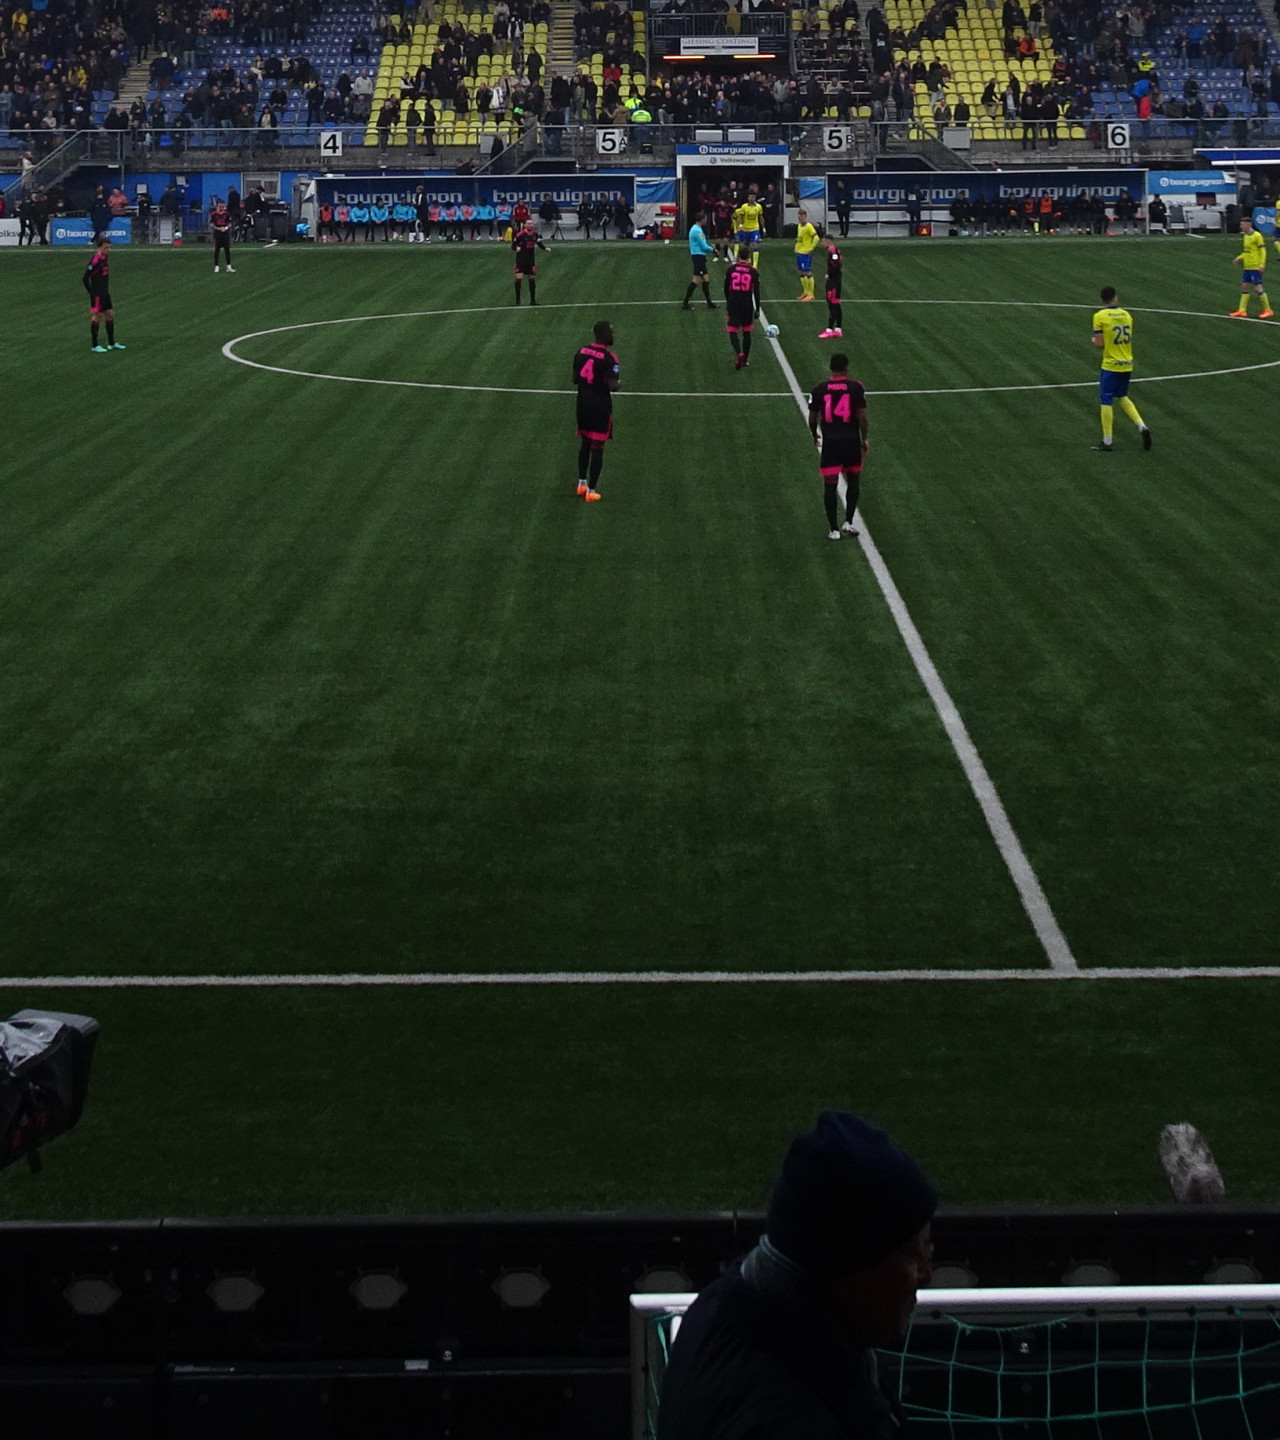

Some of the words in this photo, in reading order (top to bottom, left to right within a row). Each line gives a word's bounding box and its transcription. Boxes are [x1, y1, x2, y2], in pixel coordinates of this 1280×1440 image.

[323, 134, 339, 154] 4
[1110, 125, 1126, 146] 6
[709, 146, 766, 154] bourguignon
[731, 272, 751, 291] 29
[1112, 325, 1130, 344] 25
[580, 358, 594, 384] 4
[823, 393, 850, 423] 14
